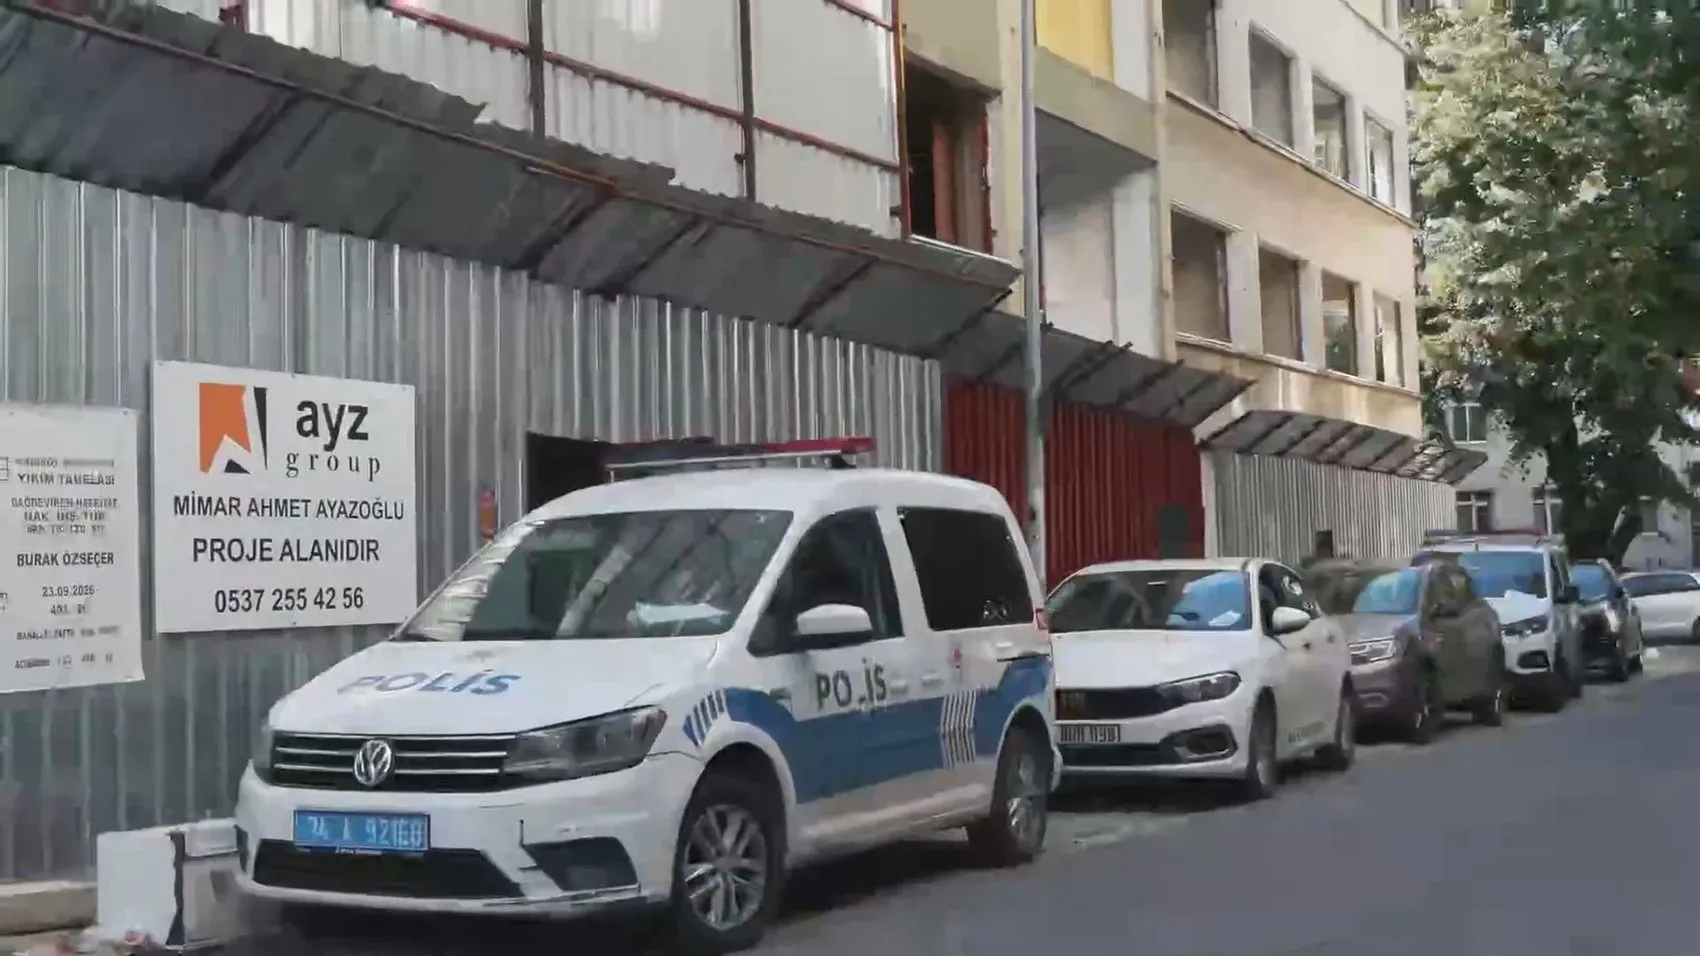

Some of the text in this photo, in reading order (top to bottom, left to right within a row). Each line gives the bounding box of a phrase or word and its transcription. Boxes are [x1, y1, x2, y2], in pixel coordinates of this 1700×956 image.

[296, 400, 369, 452] ayz
[285, 452, 381, 482] group
[173, 491, 404, 520] MİMAR AHMET AYAZOĞLU
[16, 550, 114, 567] BURAK ÖZSEÇER
[193, 537, 380, 562] PROJE ALANIDIR
[215, 586, 364, 613] 0537 255 42 56
[337, 669, 521, 695] POLİS
